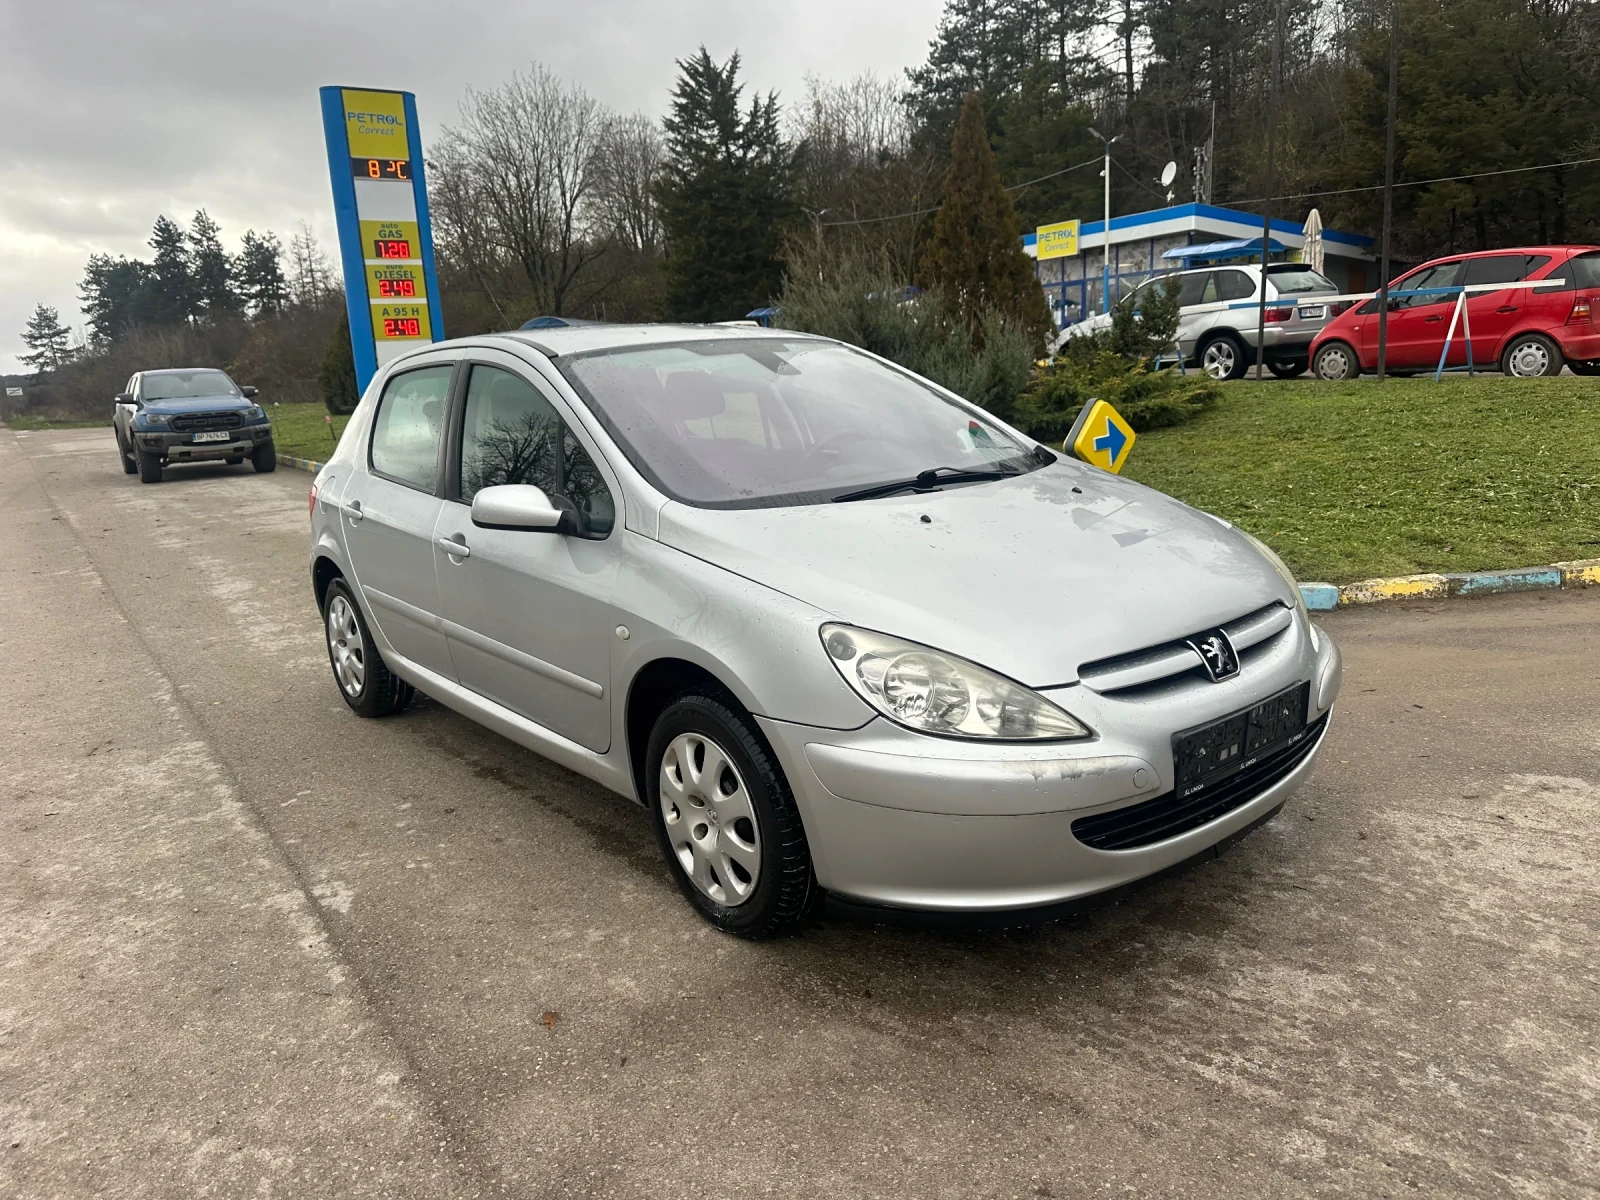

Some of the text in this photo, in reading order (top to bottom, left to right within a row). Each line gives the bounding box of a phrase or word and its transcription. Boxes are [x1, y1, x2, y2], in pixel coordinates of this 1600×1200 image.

[347, 112, 404, 126] PETROL
[358, 125, 395, 136] Correct
[368, 160, 381, 179] 8
[378, 229, 403, 239] GAS
[1038, 228, 1075, 242] PETROL
[1045, 241, 1069, 252] Correct
[374, 270, 416, 280] DIESEL
[379, 280, 415, 297] 2.49
[381, 308, 420, 317] A 95 H
